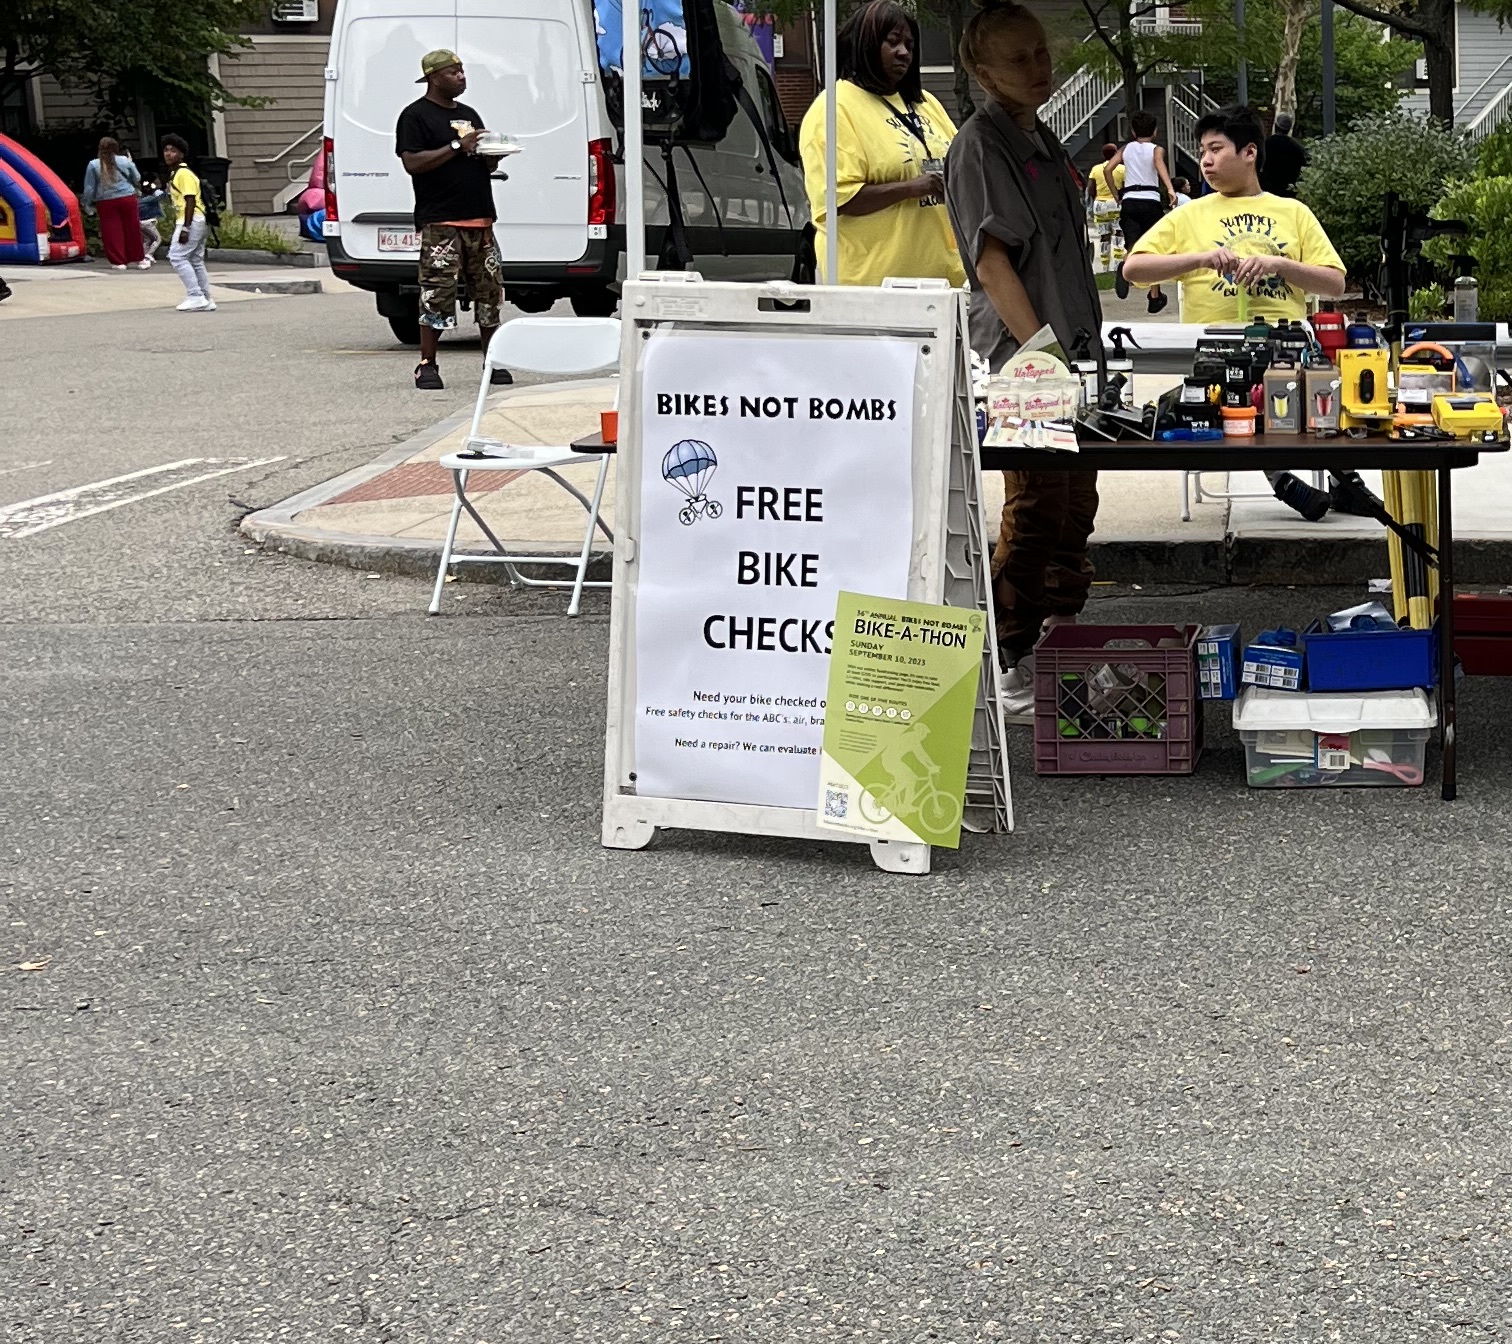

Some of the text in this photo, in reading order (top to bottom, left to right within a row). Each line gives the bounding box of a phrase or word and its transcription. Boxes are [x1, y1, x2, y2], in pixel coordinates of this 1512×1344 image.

[1219, 212, 1277, 228] SUMMER
[401, 233, 421, 246] 415
[657, 393, 897, 421] BIKES NOT BOMBS
[736, 486, 824, 522] FREE
[737, 551, 820, 587] BIKE
[923, 619, 940, 628] NOT
[854, 618, 967, 649] BIKE-A-THON
[850, 639, 884, 651] SUNDAY
[848, 648, 893, 662] SEPTEMBER
[908, 656, 926, 667] 2023
[693, 690, 720, 703] Need
[723, 695, 748, 706] your
[750, 693, 772, 706] bike
[774, 695, 817, 708] checked
[645, 707, 666, 717] Free
[668, 708, 696, 720] safety
[697, 710, 728, 721] checks
[729, 711, 744, 721] for
[745, 712, 760, 722] the
[674, 737, 699, 748] Need
[708, 741, 740, 751] repair?
[742, 742, 757, 752] We
[759, 745, 776, 753] can
[777, 745, 818, 756] evaluate
